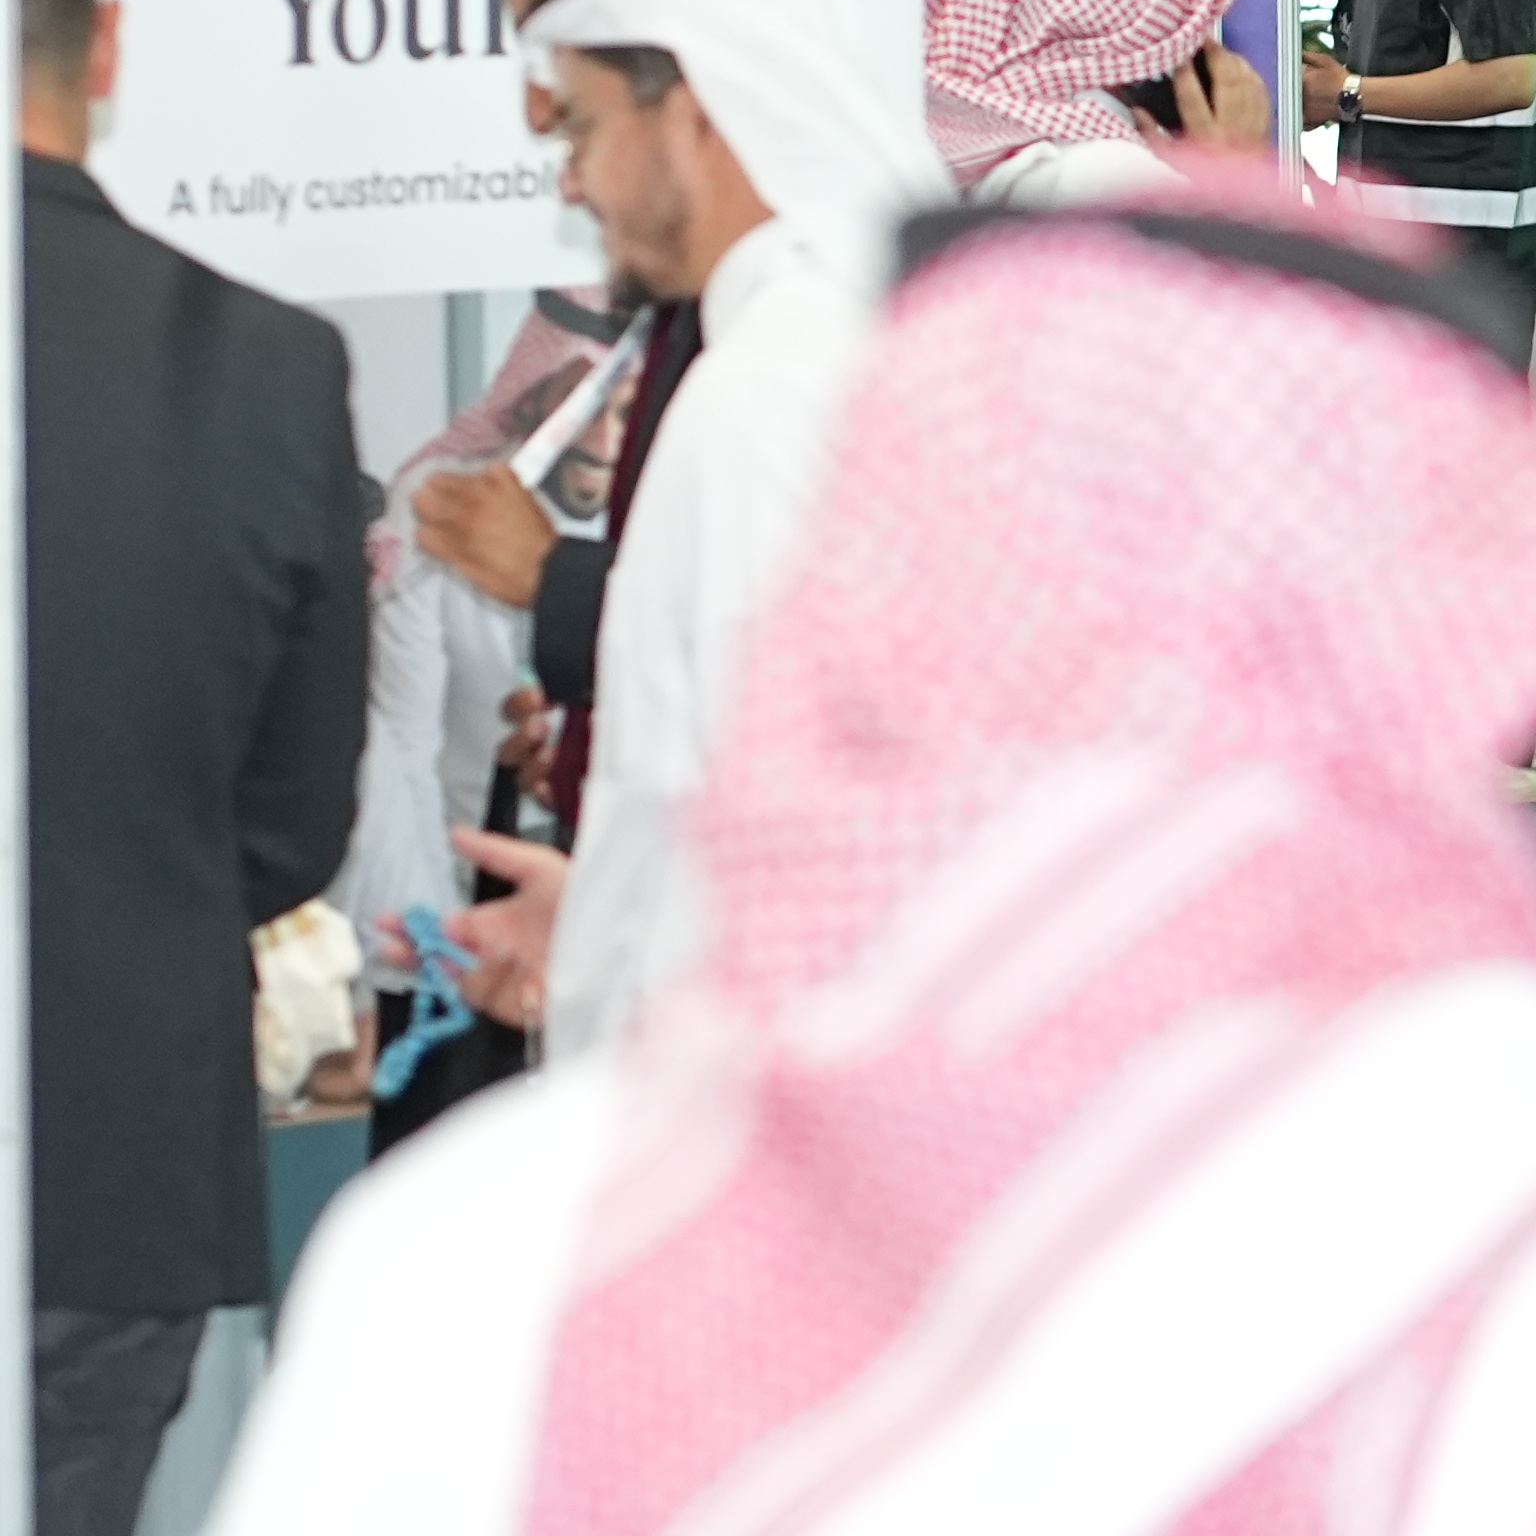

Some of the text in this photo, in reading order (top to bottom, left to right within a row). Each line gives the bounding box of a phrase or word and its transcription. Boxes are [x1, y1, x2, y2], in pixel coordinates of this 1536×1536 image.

[170, 159, 556, 225] A fully customizabl
